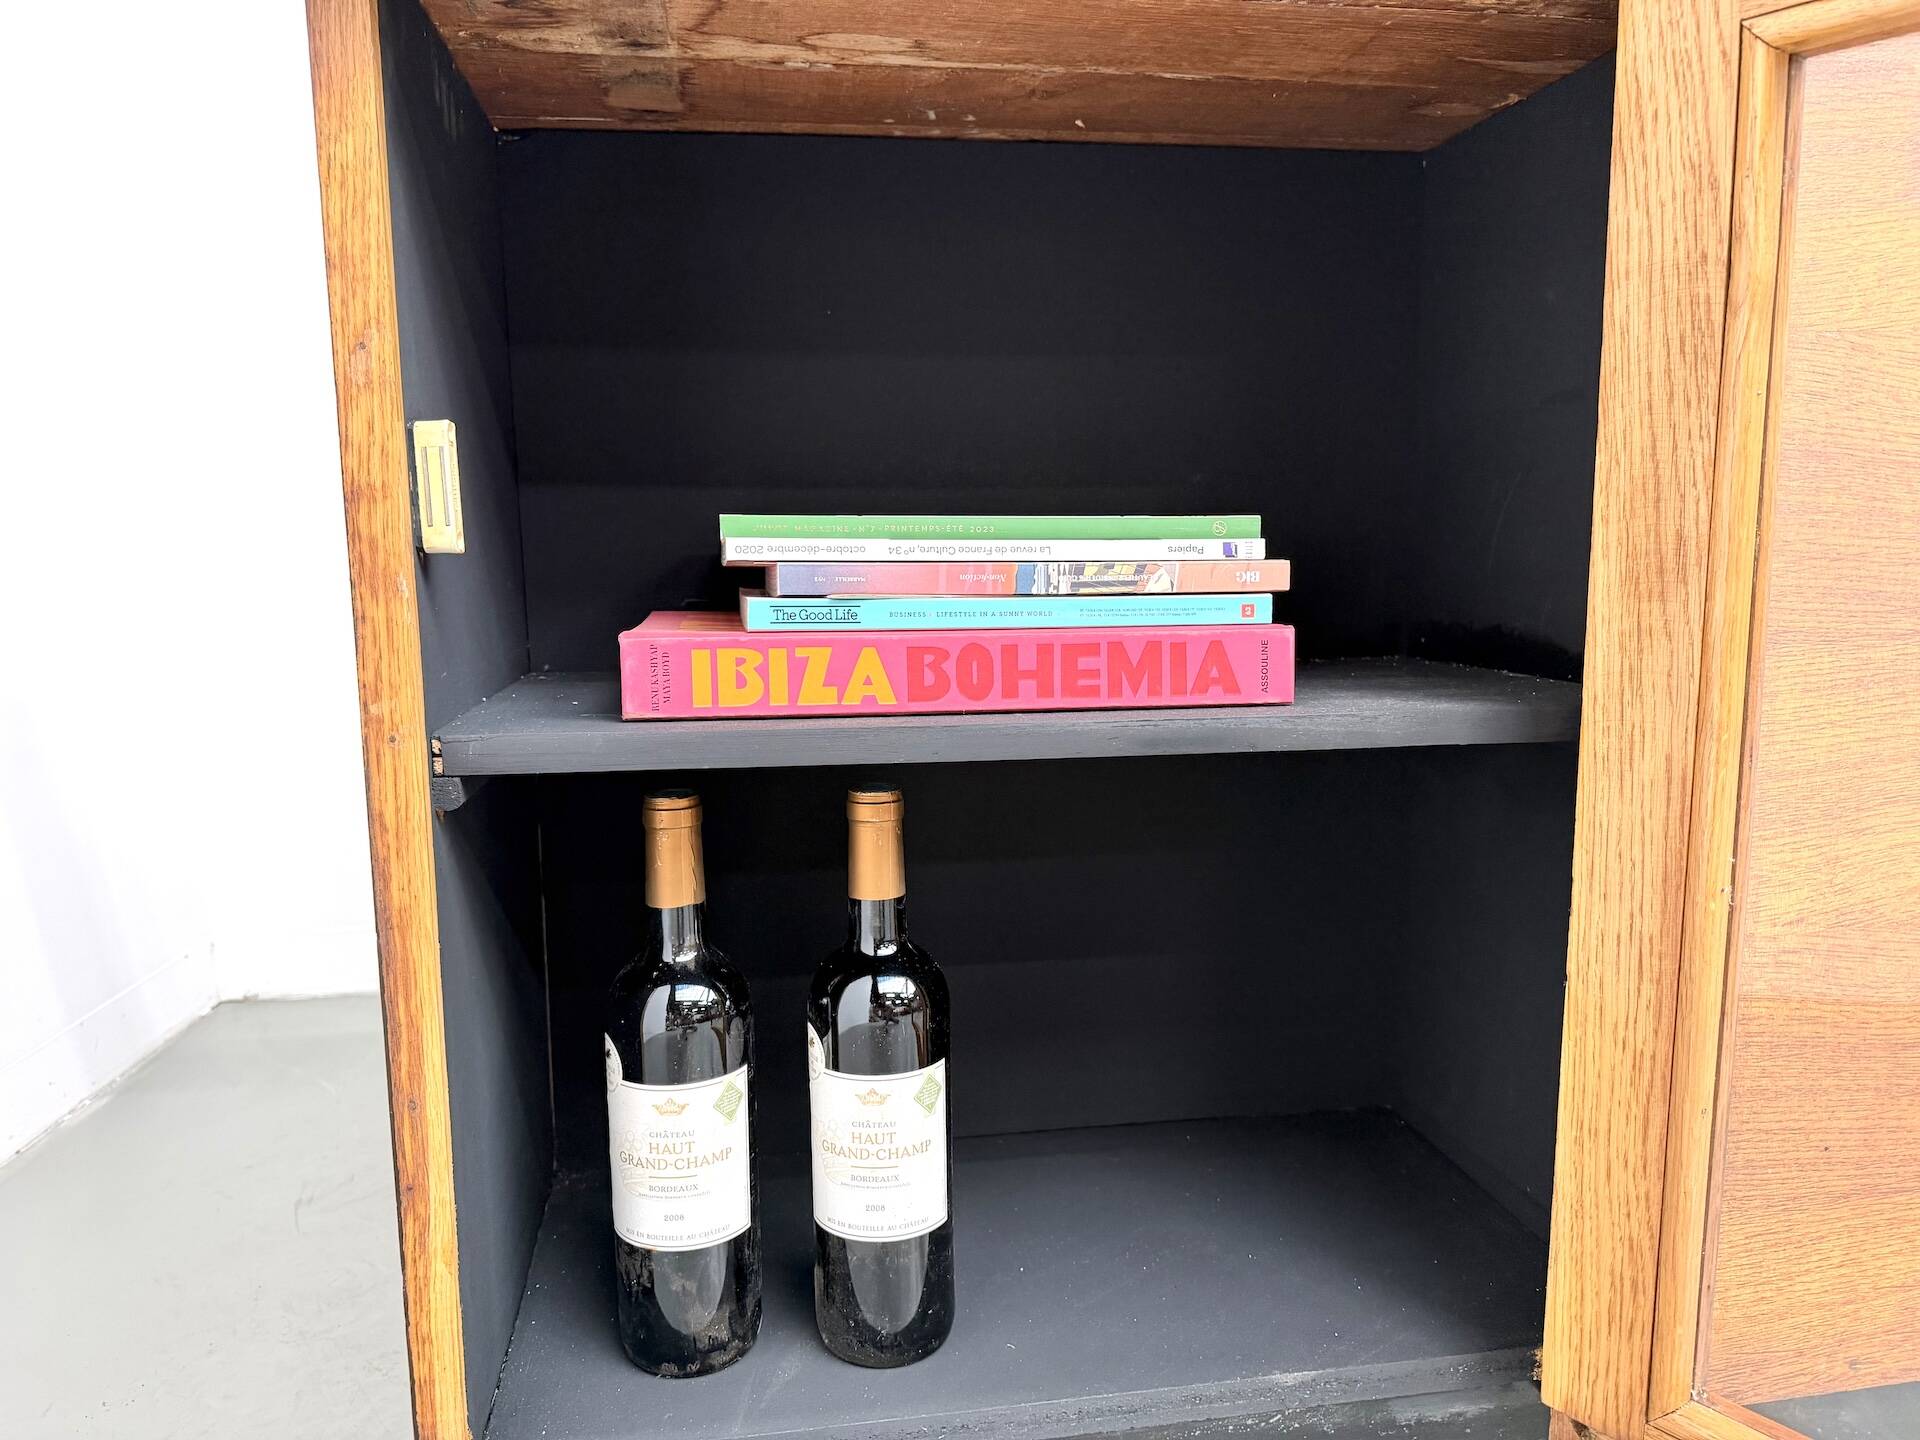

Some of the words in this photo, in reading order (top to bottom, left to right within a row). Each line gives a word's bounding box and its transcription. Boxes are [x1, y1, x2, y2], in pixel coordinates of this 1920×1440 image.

[970, 525, 995, 533] 2023
[734, 545, 764, 554] 2020
[766, 544, 866, 555] octobre-décembre
[917, 546, 956, 555] Culture,
[958, 546, 992, 555] France
[994, 546, 1007, 555] de
[1040, 546, 1051, 555] La
[1168, 546, 1204, 555] Papiers
[773, 609, 797, 621] The
[799, 609, 833, 621] Good
[835, 609, 858, 621] Life
[650, 644, 659, 686] KASHYAP
[662, 651, 670, 677] BOYD
[1261, 639, 1269, 694] ASSOULINE
[691, 646, 897, 708] IBIZA
[906, 640, 1242, 703] BOHEMIA
[663, 679, 671, 704] MAYA
[651, 688, 660, 712] RENU
[851, 1120, 896, 1129] CHÂTEAU
[648, 1129, 695, 1139] CHÂTEAU
[851, 1131, 897, 1145] HAUT
[648, 1141, 696, 1155] HAUT
[822, 1139, 931, 1161] GRAND-CHAMP
[619, 1146, 732, 1171] GRAND-CHAMP
[850, 1174, 900, 1183] BORDEAUX
[648, 1183, 699, 1193] BORDEAUX
[837, 1220, 846, 1228] EN
[848, 1223, 884, 1232] BOUTEILLE
[636, 1230, 645, 1238] EN
[646, 1233, 683, 1241] BOUTEILLE
